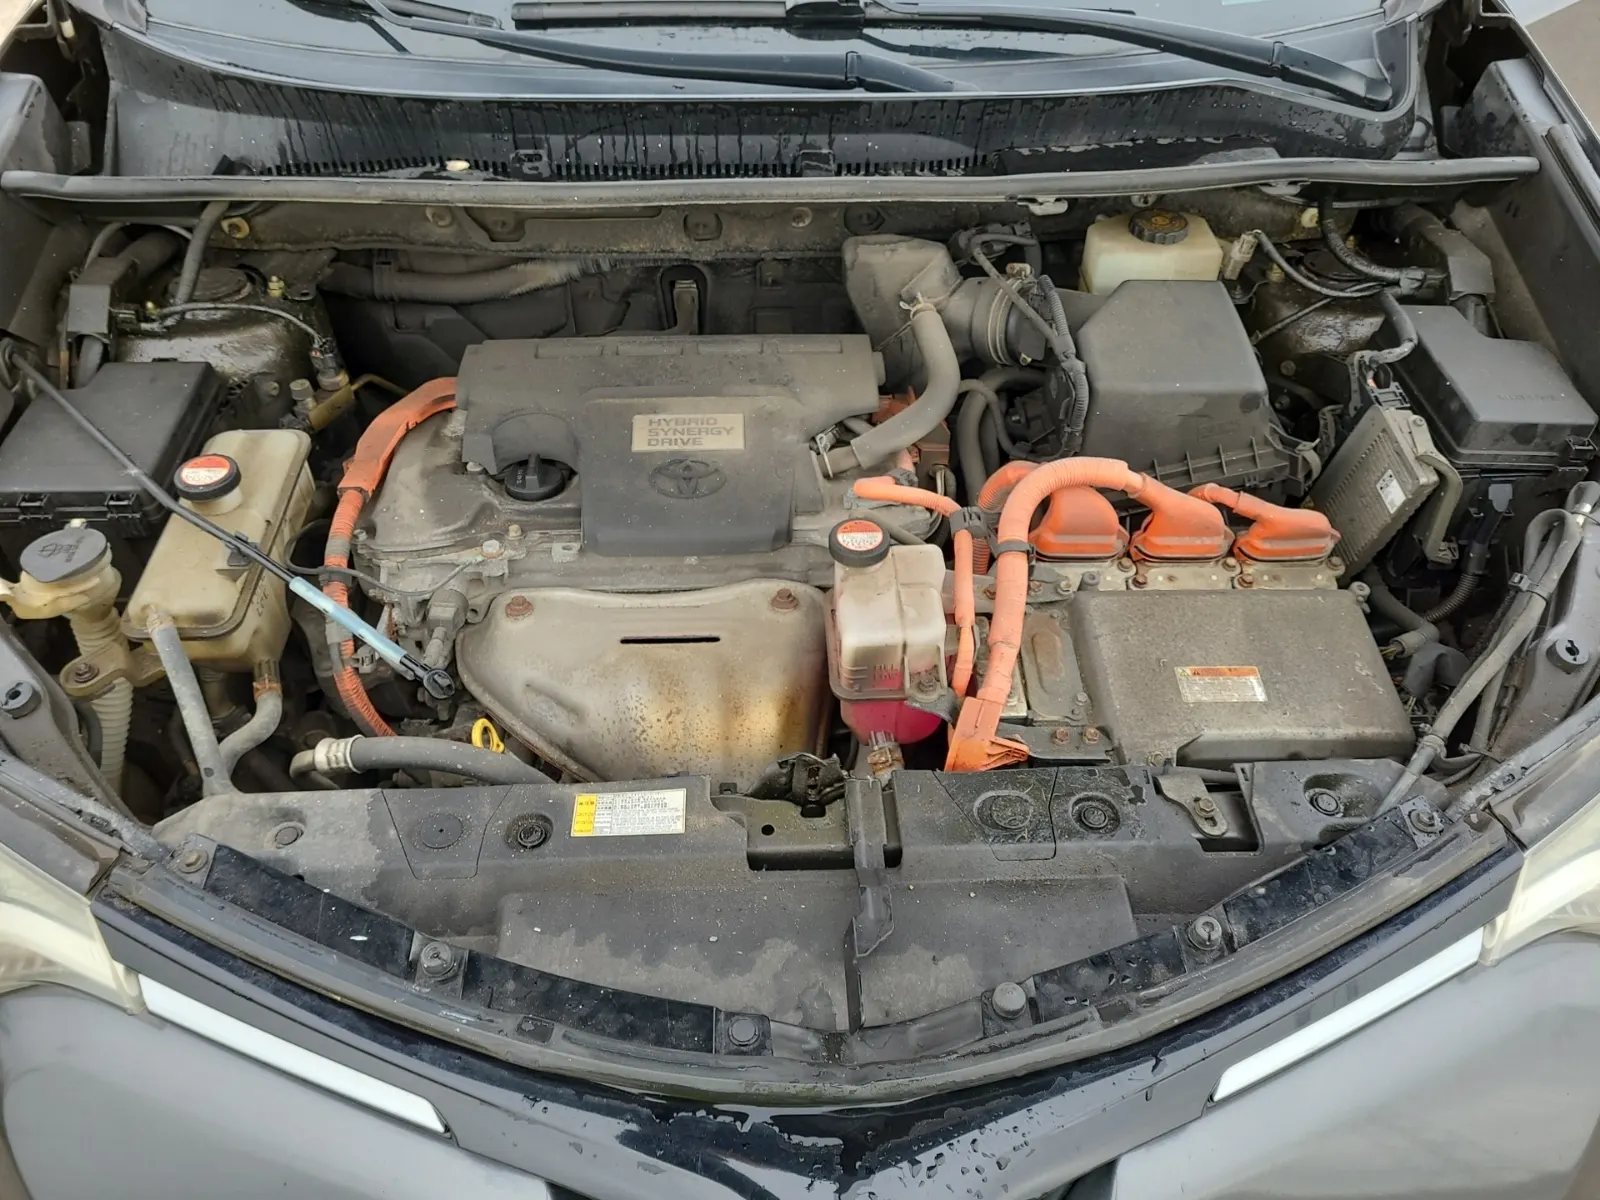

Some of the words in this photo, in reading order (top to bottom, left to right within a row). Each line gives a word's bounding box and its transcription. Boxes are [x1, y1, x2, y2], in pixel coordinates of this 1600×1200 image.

[648, 417, 718, 426] HYBRID
[648, 427, 735, 436] SYNERGY
[647, 437, 704, 447] DRIVE
